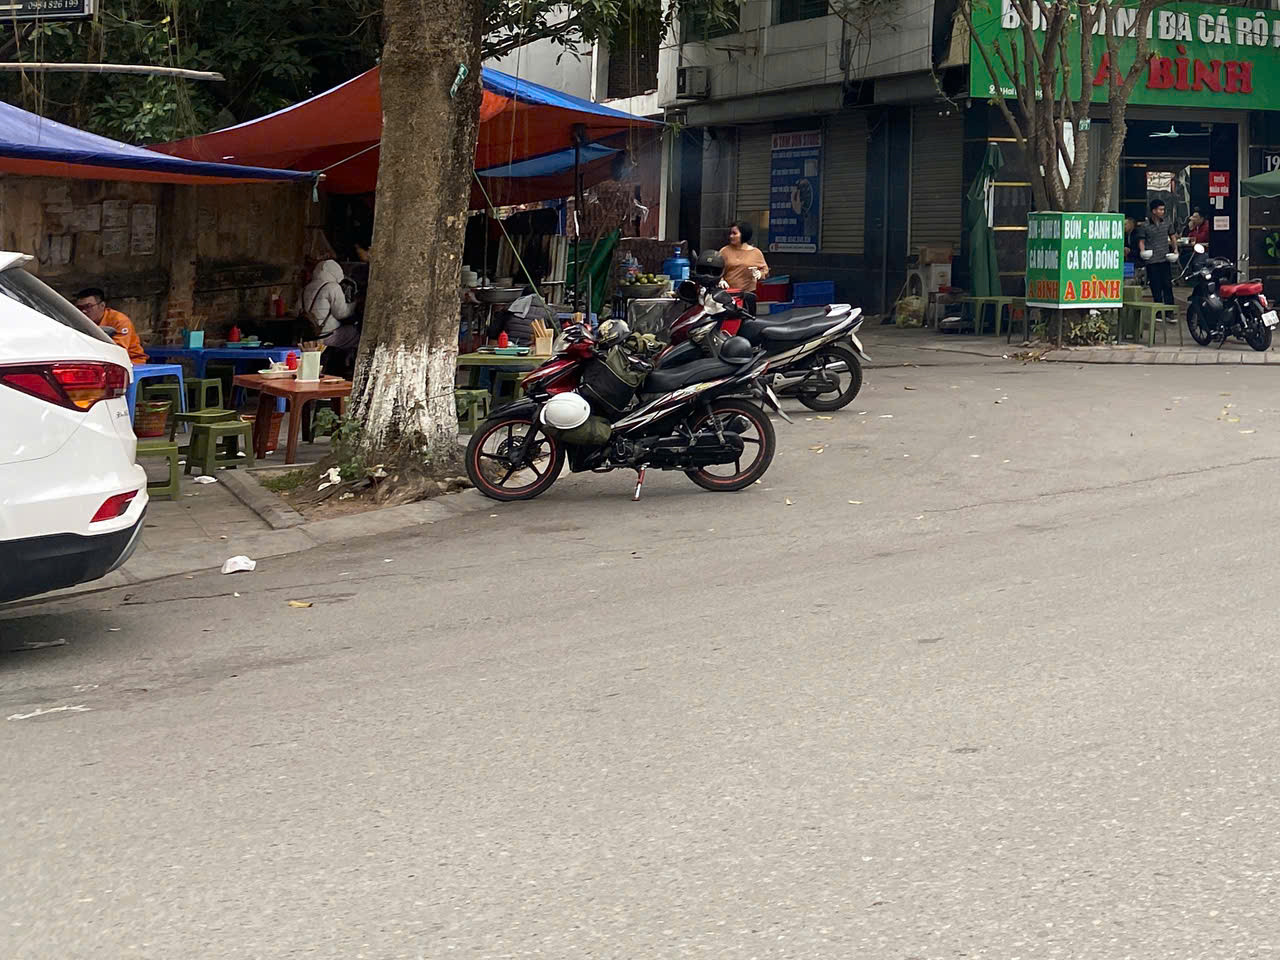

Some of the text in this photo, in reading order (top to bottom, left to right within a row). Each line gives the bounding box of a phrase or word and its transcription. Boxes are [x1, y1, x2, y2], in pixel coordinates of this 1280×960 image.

[1197, 9, 1232, 44] CÁ
[1236, 12, 1270, 47] RÔ
[1092, 44, 1254, 94] A BÌNH
[1265, 155, 1280, 171] 19
[1064, 216, 1082, 239] BÚN
[1088, 216, 1110, 239] BÁNH
[1112, 220, 1123, 239] ĐA
[1067, 246, 1079, 270] CÁ
[1081, 246, 1094, 269] RÔ
[1064, 274, 1121, 300] A BÌNH
